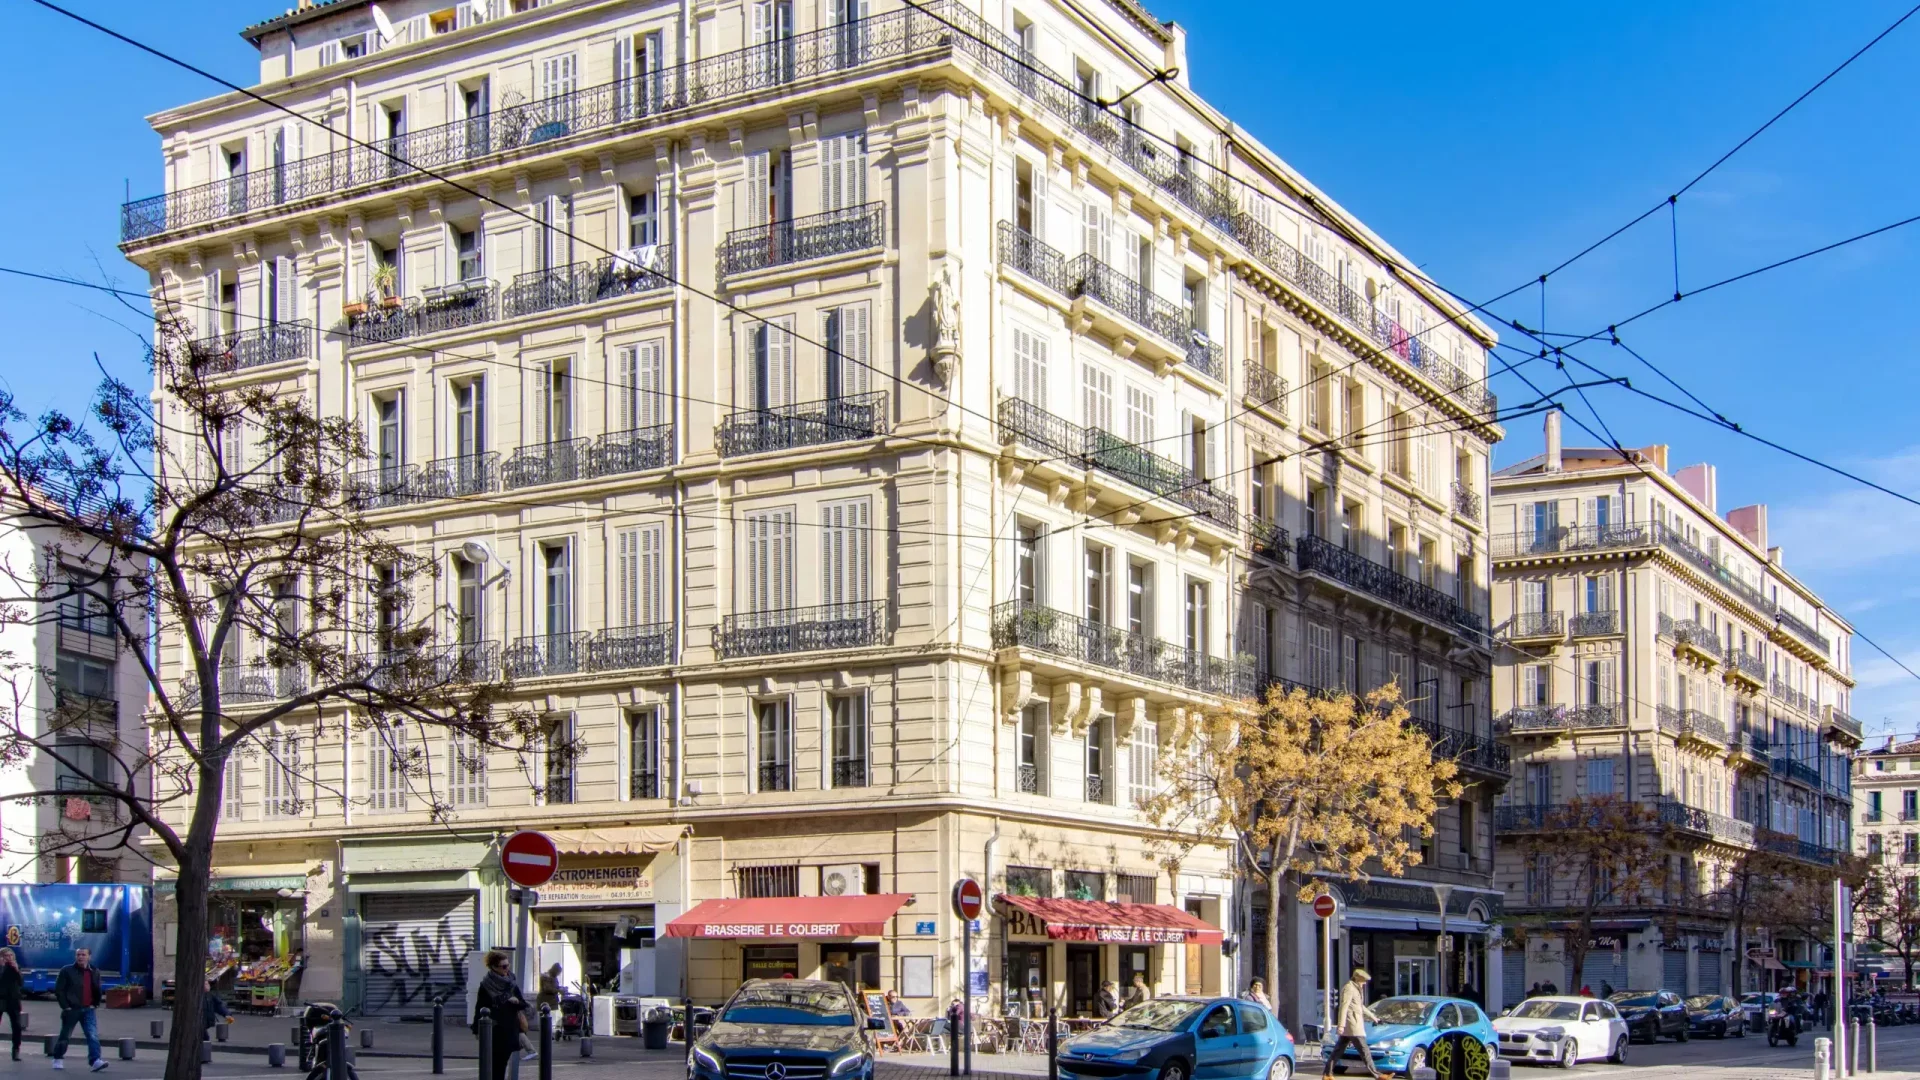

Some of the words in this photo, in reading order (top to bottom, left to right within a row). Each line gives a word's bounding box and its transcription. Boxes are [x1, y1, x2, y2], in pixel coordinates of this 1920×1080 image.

[551, 866, 641, 881] ECTROMENAGER
[601, 879, 650, 890] PARABOLES
[548, 893, 579, 901] REPARATION
[704, 924, 765, 936] BRASSERIE
[769, 924, 784, 936] LE
[788, 923, 841, 935] COLBERT
